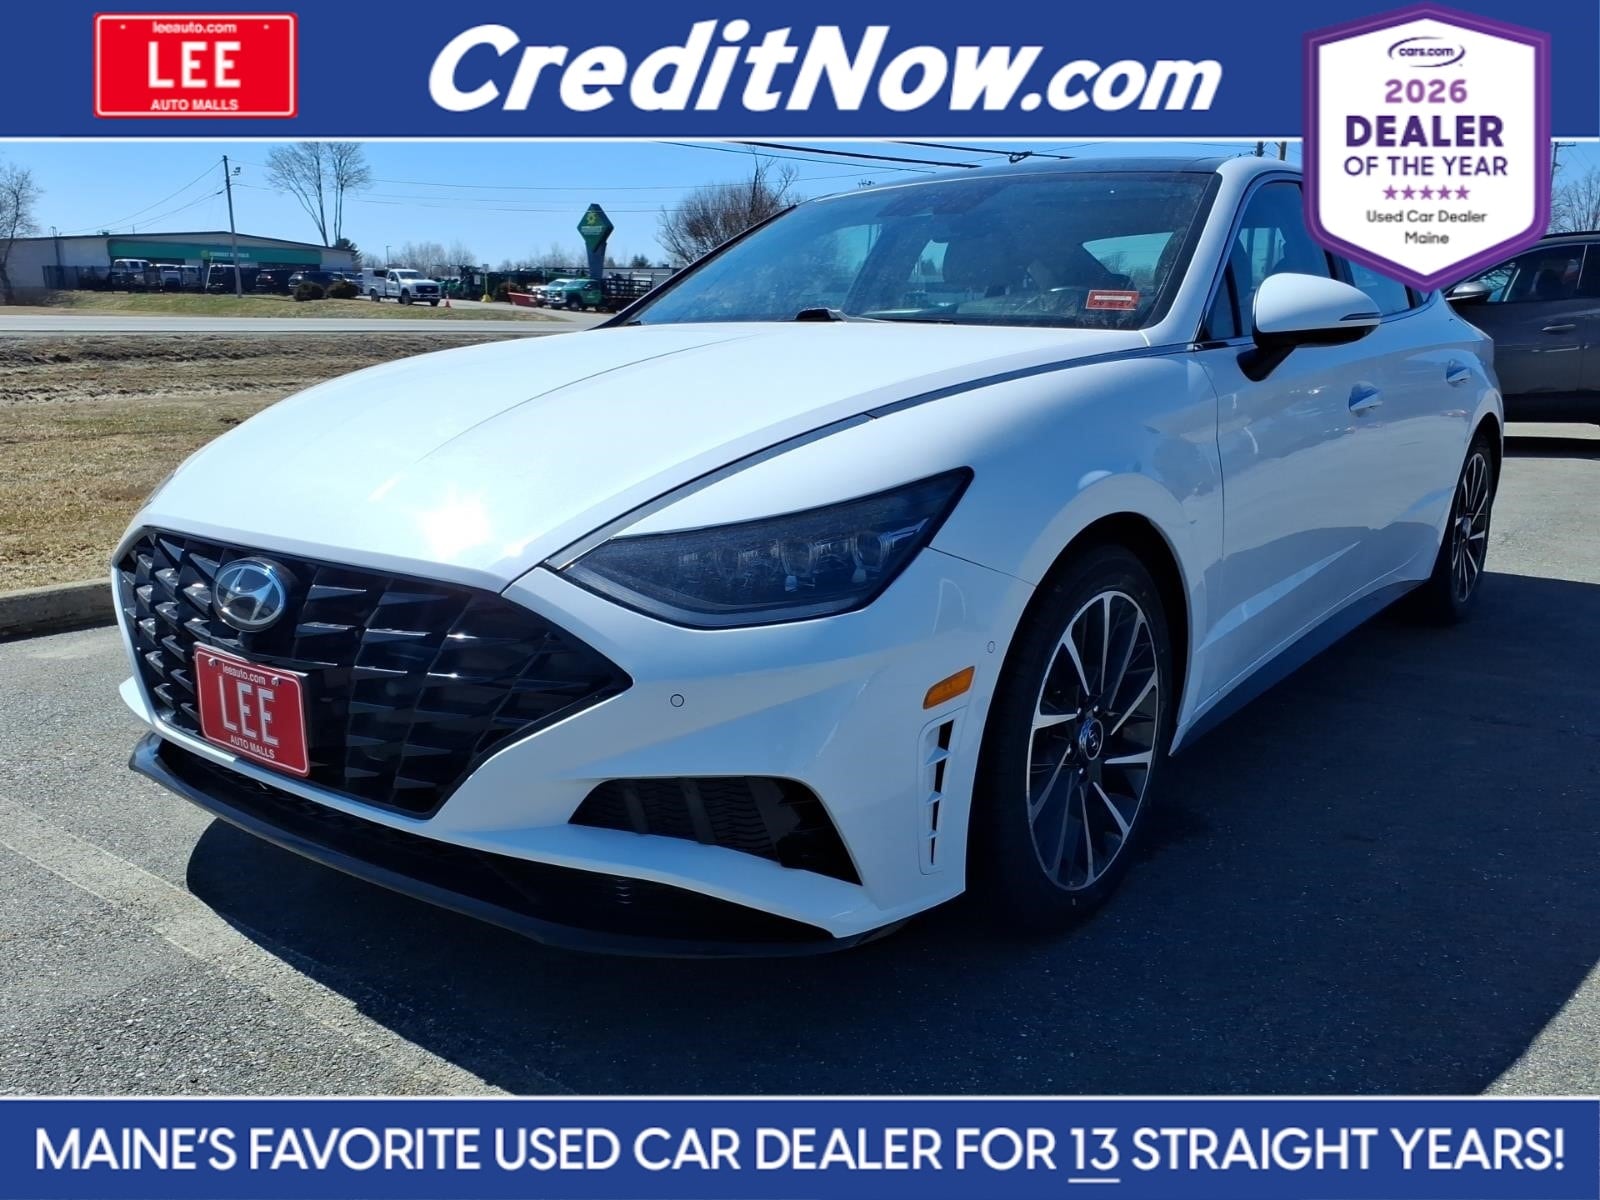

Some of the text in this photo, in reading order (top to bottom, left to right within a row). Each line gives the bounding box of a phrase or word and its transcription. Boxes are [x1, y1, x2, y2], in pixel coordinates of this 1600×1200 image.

[222, 663, 265, 686] leeauto.com
[218, 675, 278, 746] LEE
[230, 734, 275, 759] AUTO MALLS
